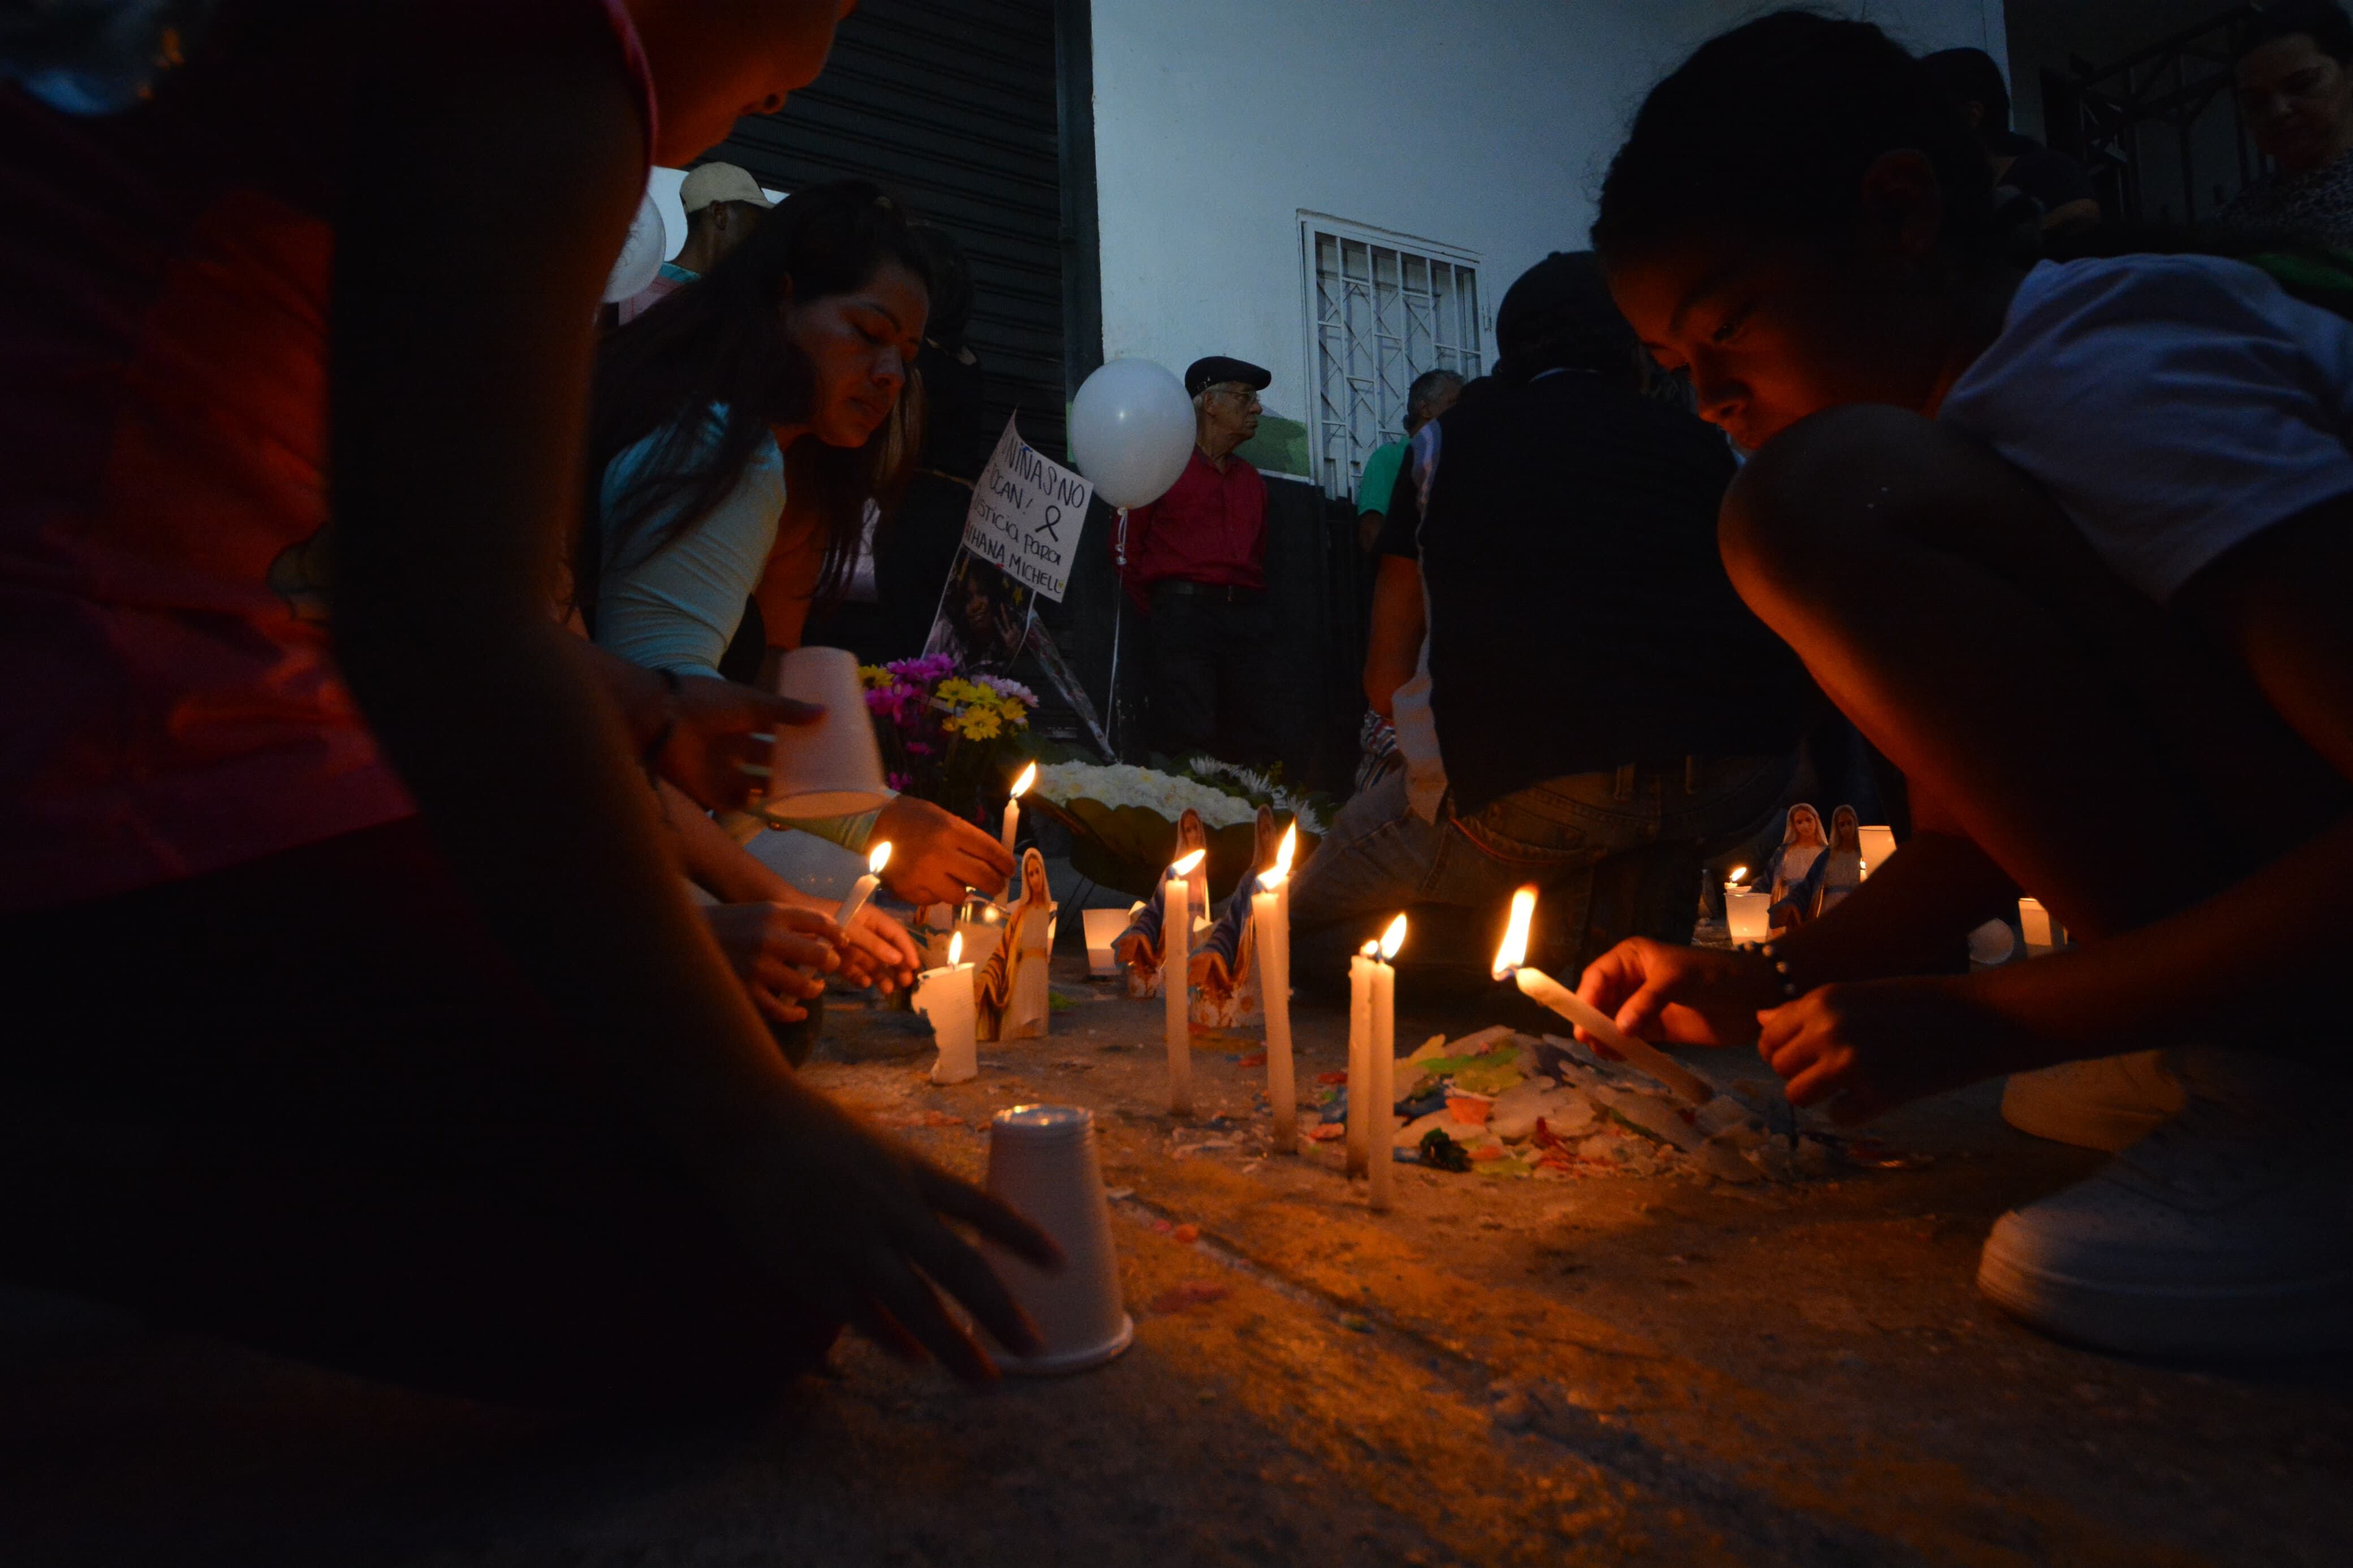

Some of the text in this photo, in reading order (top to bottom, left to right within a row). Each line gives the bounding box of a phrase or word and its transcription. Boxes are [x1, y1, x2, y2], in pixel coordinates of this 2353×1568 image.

[989, 465, 1033, 515] OCAN!
[1057, 478, 1085, 508] NO
[1009, 552, 1061, 594] MICHELL
